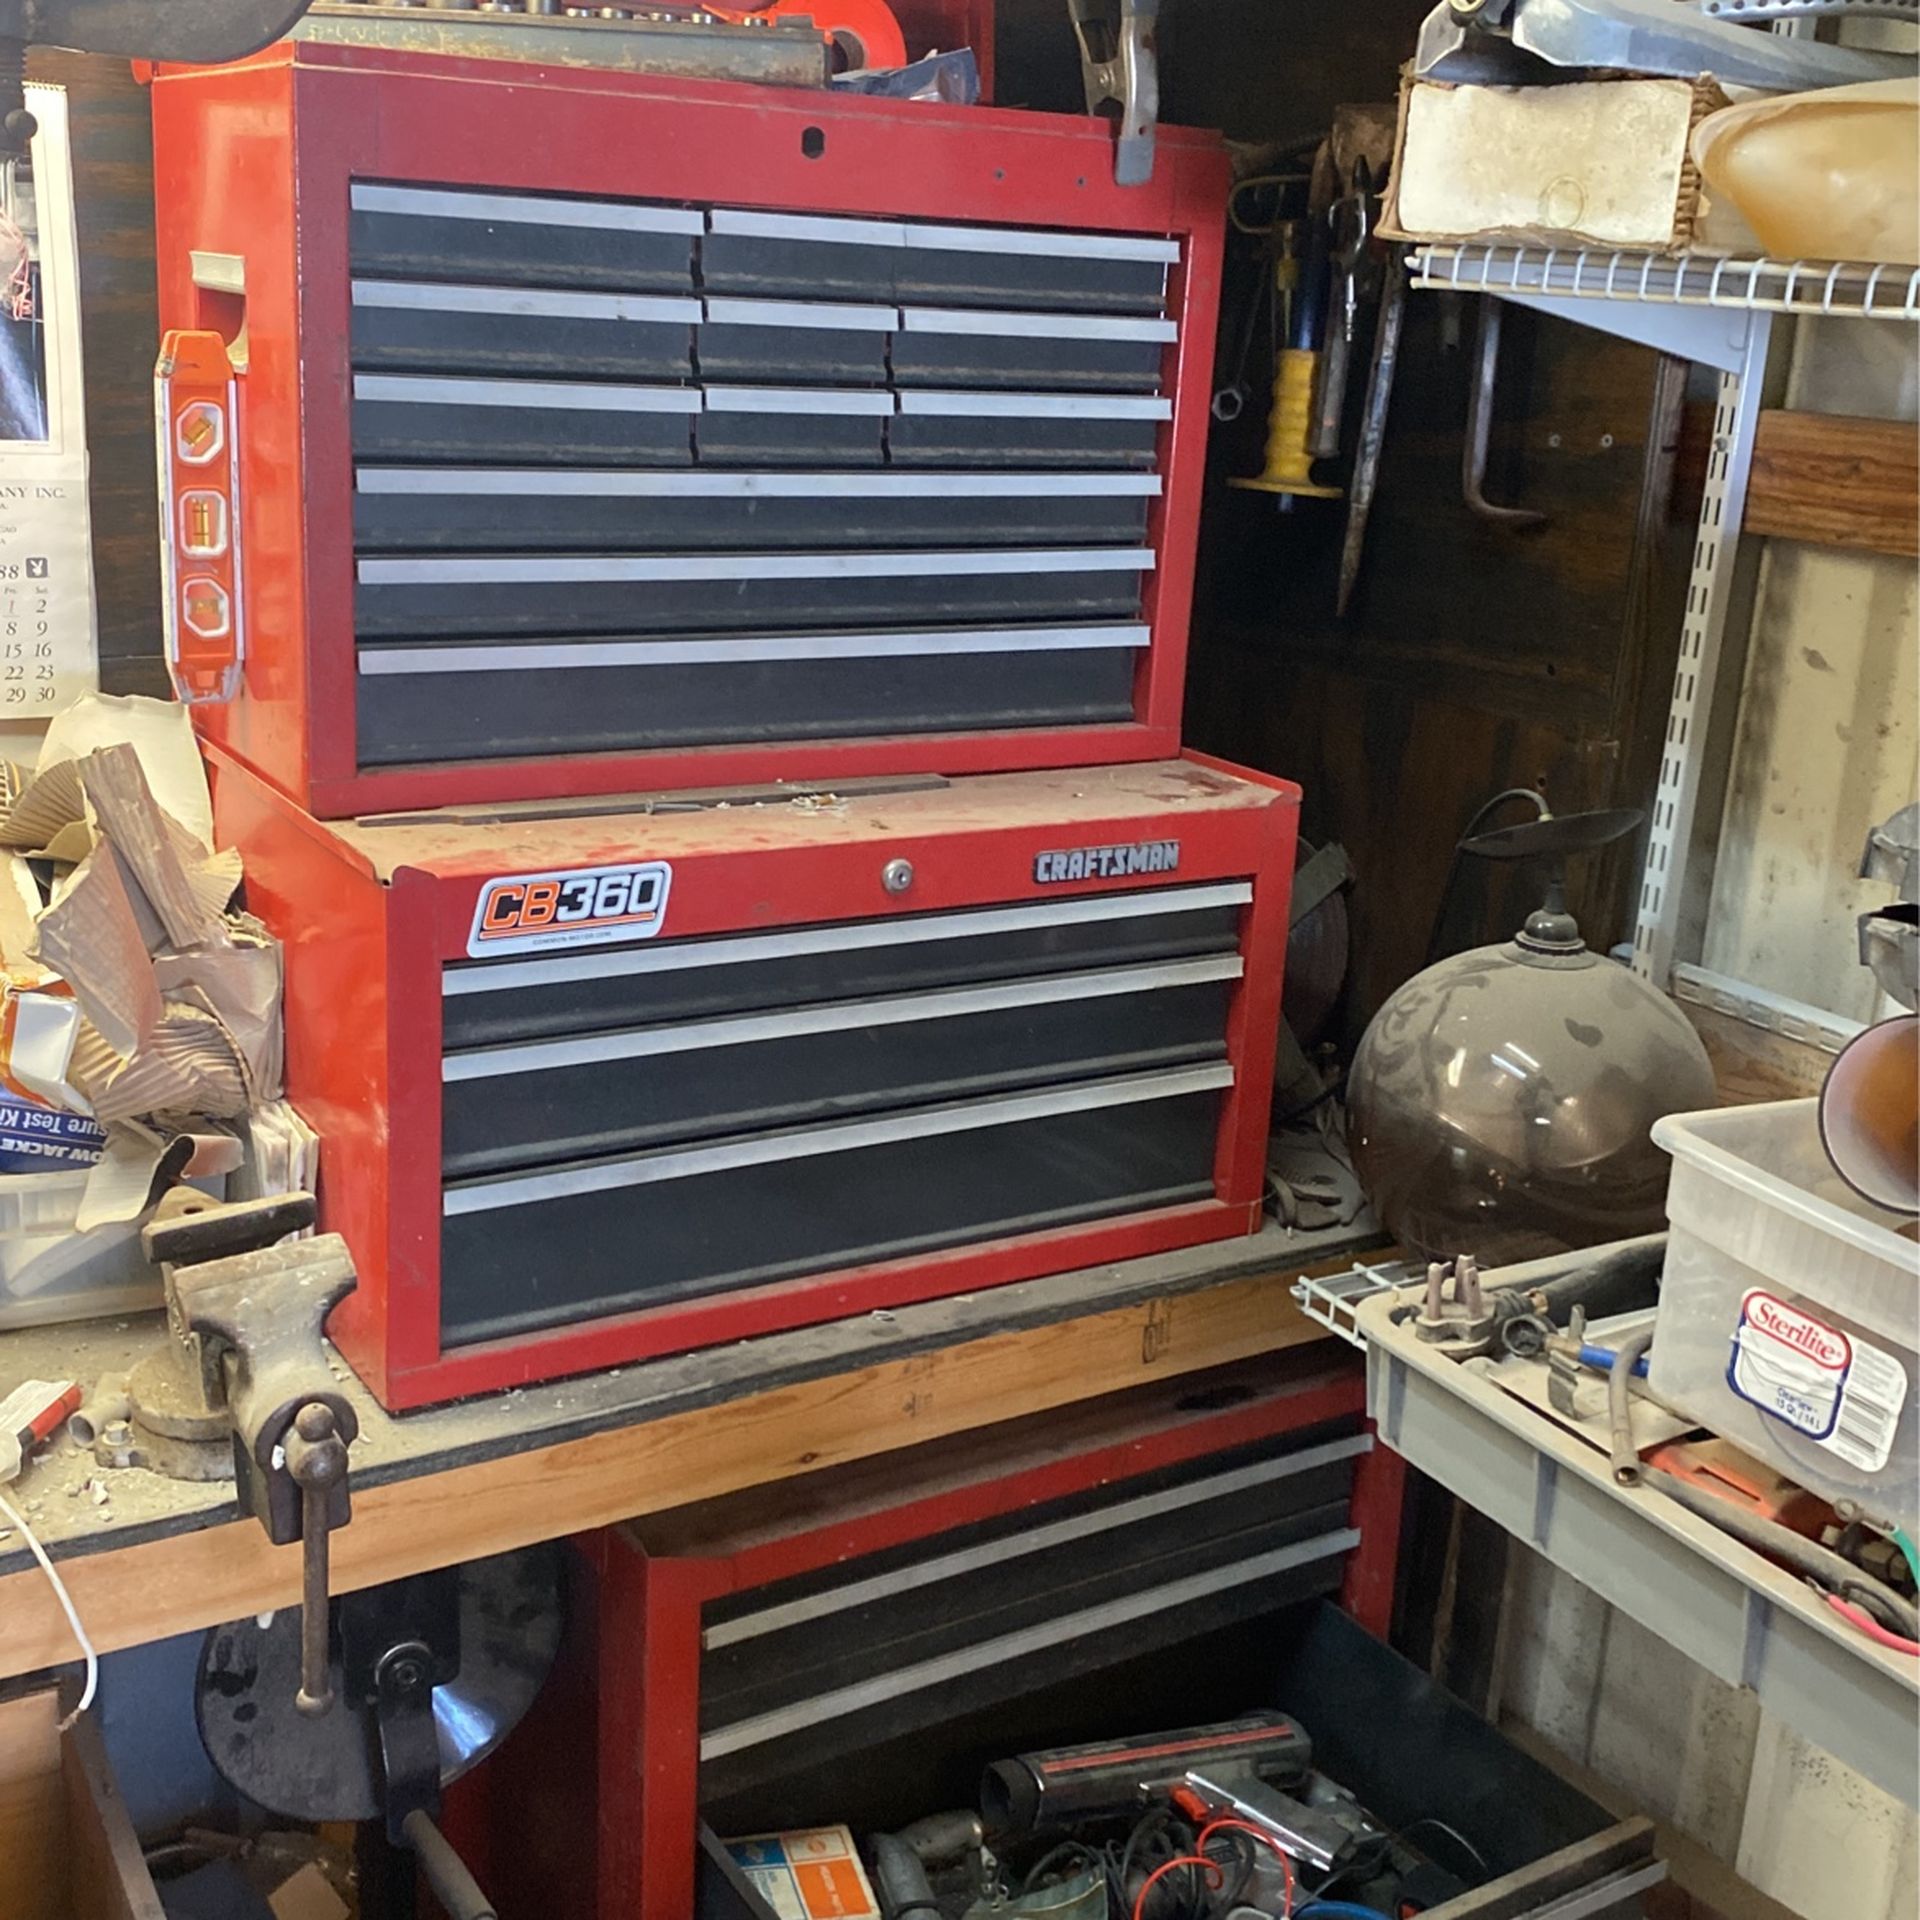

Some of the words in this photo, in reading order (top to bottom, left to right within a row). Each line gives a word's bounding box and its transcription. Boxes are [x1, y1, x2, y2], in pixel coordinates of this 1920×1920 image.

[35, 487, 66, 498] INC.
[36, 598, 47, 613] 2
[6, 620, 18, 636] 8
[36, 620, 49, 637] 9
[5, 643, 22, 659] 15
[35, 641, 52, 658] 16
[4, 665, 24, 680] 22
[35, 664, 54, 681] 23
[6, 686, 27, 703] 29
[35, 686, 56, 703] 30
[1035, 841, 1180, 883] CRAFTSMAN
[483, 871, 665, 931] CB360
[22, 1111, 62, 1134] Test
[0, 1137, 70, 1158] JACKE
